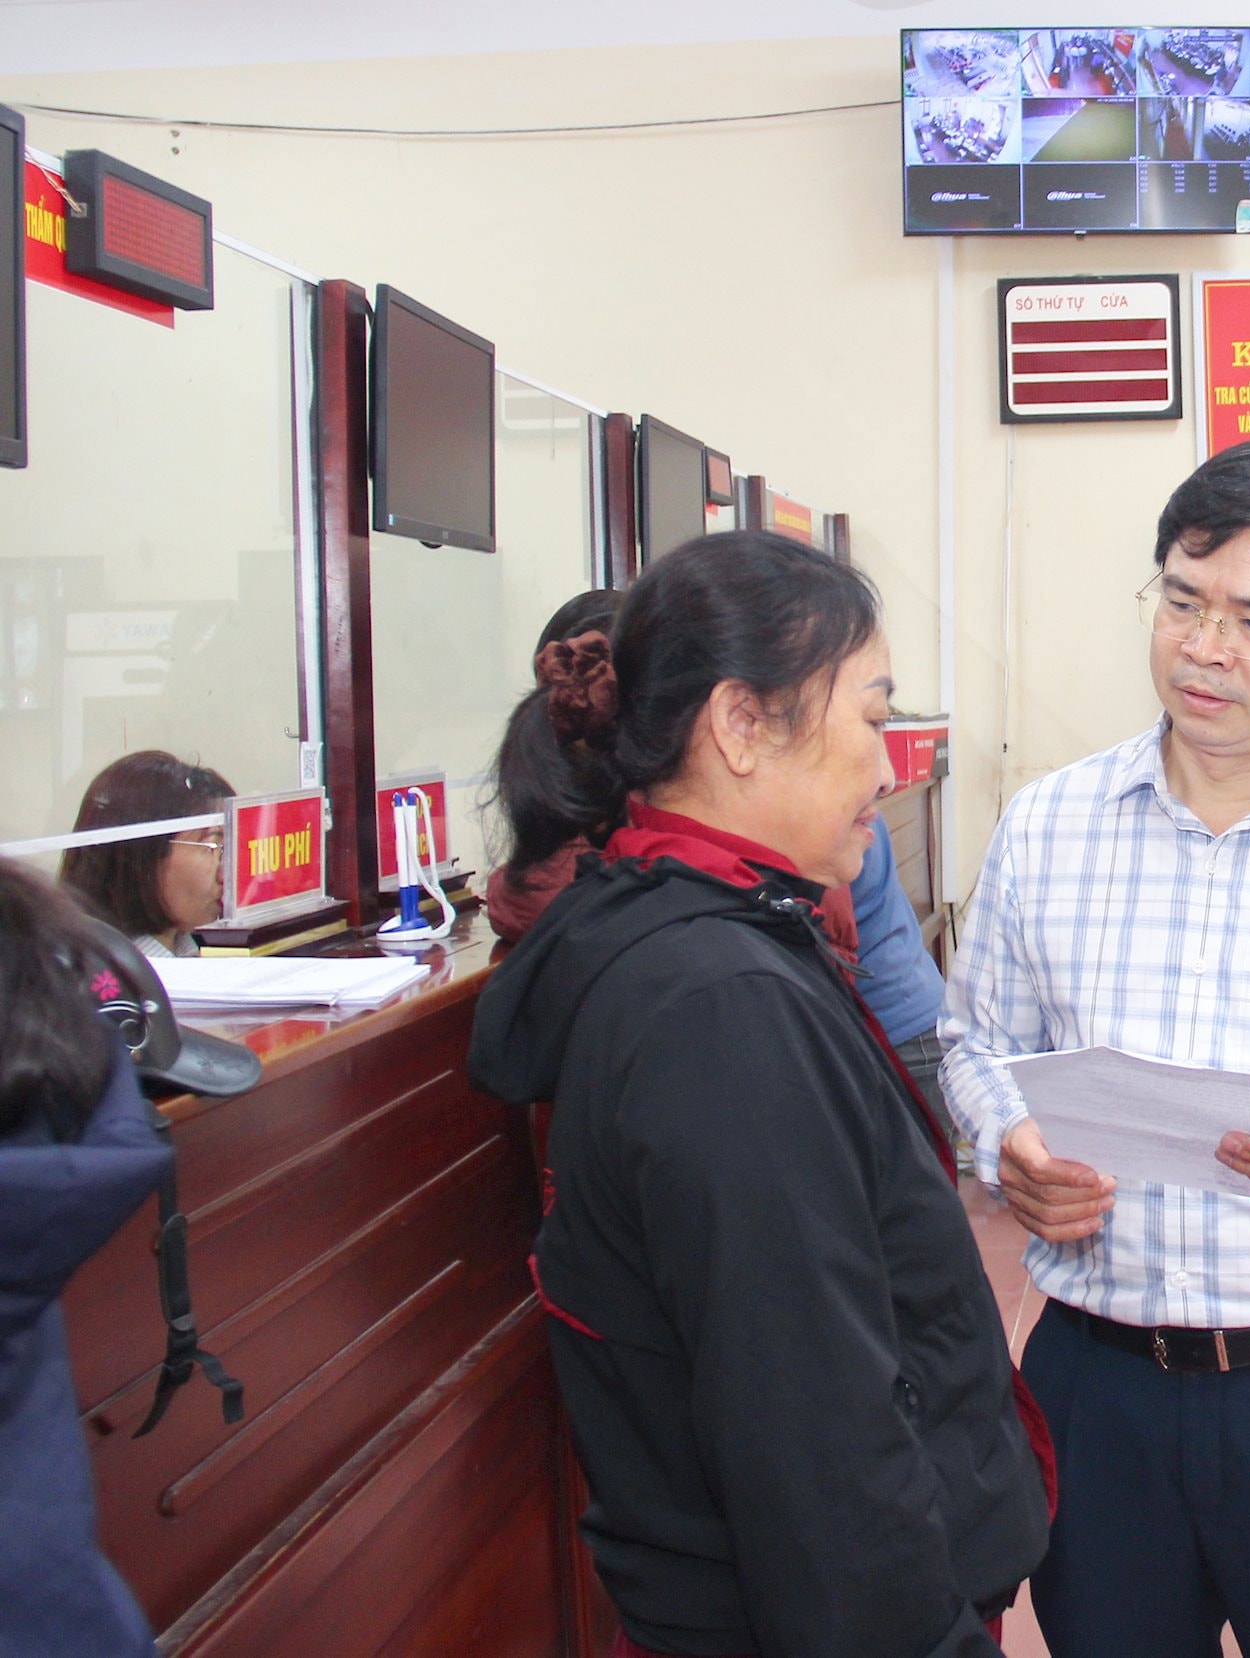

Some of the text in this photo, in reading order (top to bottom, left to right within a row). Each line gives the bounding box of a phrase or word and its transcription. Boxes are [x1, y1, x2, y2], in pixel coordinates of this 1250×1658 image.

[25, 195, 53, 246] THẨM
[1015, 292, 1128, 312] SỐ THỨ TỰ CỬA
[1214, 386, 1236, 405] TRA
[247, 822, 311, 876] THU PHÍ
